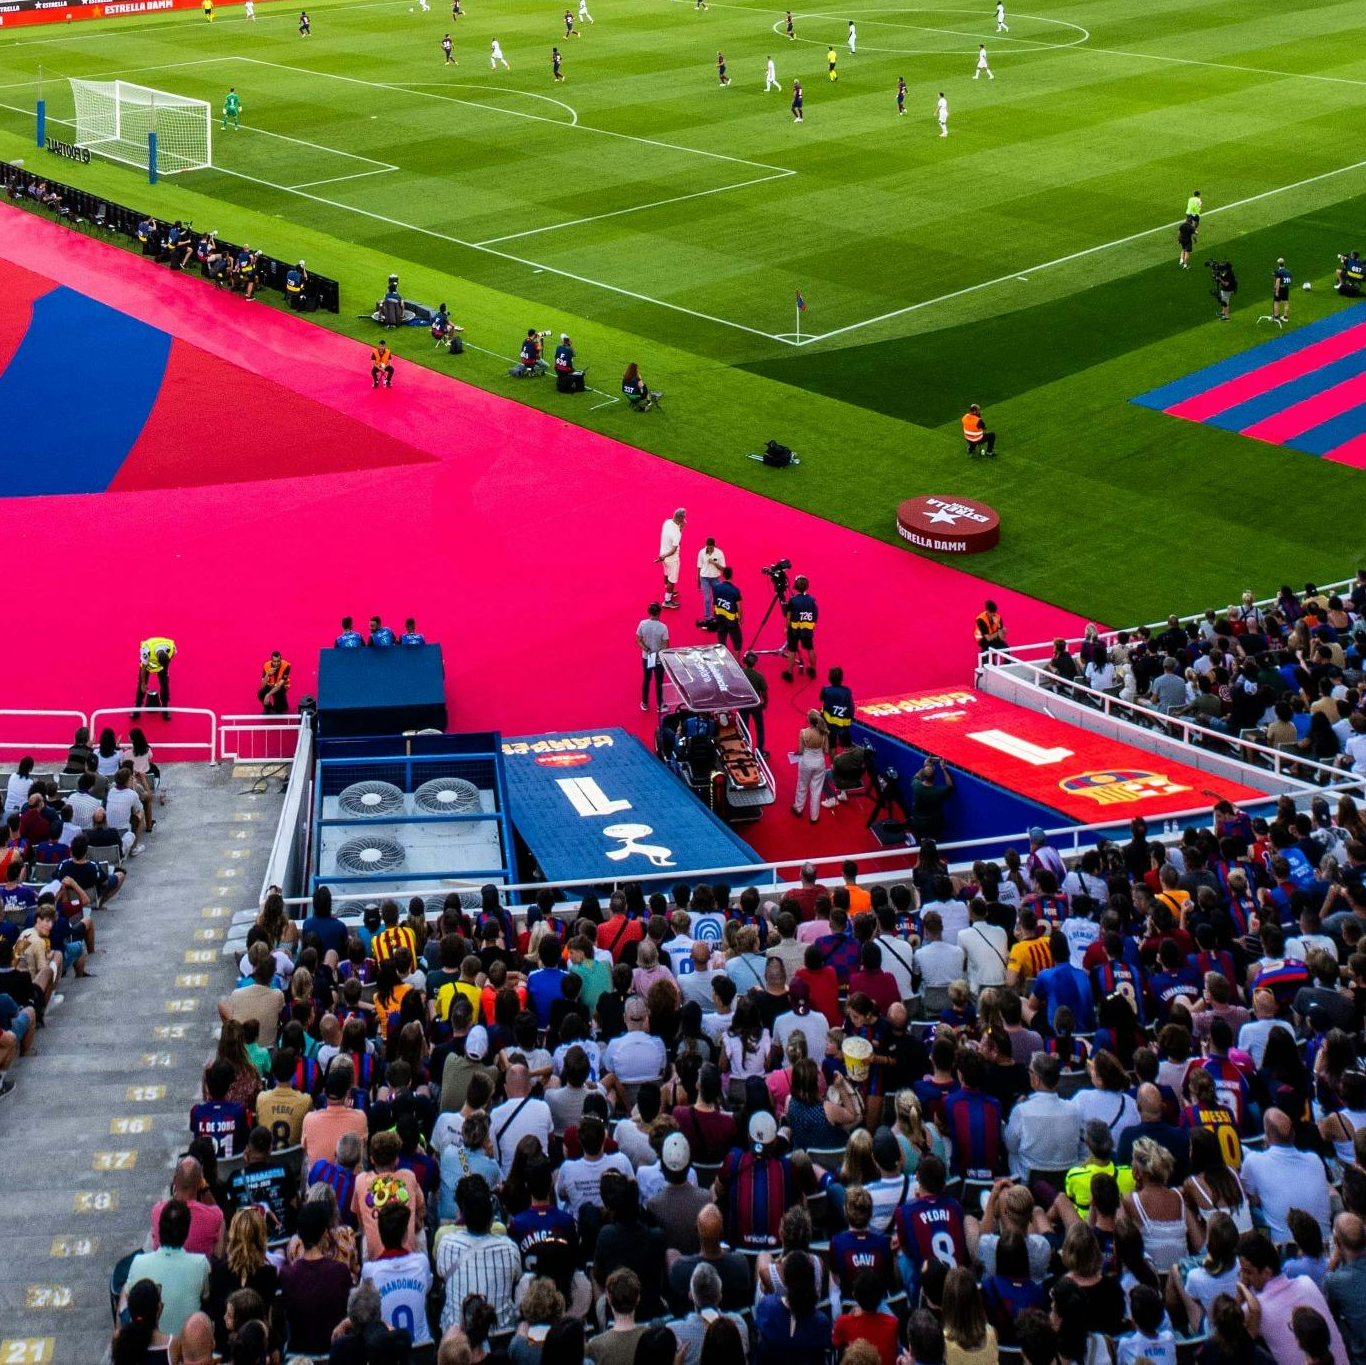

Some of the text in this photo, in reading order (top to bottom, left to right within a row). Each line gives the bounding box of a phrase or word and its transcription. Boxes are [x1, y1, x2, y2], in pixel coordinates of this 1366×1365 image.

[43, 1, 68, 9] ESTRELLA
[105, 0, 173, 15] ESTRELLA DAMM
[934, 540, 966, 551] DAMM
[717, 598, 731, 611] 725
[799, 612, 813, 622] 726
[231, 849, 240, 858] 5
[225, 868, 235, 877] 6
[212, 907, 221, 917] 8
[203, 929, 214, 939] 9
[191, 951, 211, 962] 10
[184, 973, 202, 986] 11
[172, 999, 195, 1011] 12
[161, 1026, 184, 1038] 13
[134, 1086, 159, 1101] 15
[271, 1105, 294, 1115] PEDRI
[1200, 1109, 1231, 1124] MESSI
[117, 1118, 144, 1133] 16
[217, 1121, 236, 1132] JONG
[101, 1151, 131, 1168] 17
[82, 1191, 112, 1210] 18
[919, 1208, 950, 1225] PEDRI
[744, 1234, 768, 1244] unicef
[931, 1232, 957, 1270] 8
[852, 1253, 874, 1267] GAVI
[5, 1340, 46, 1363] 21
